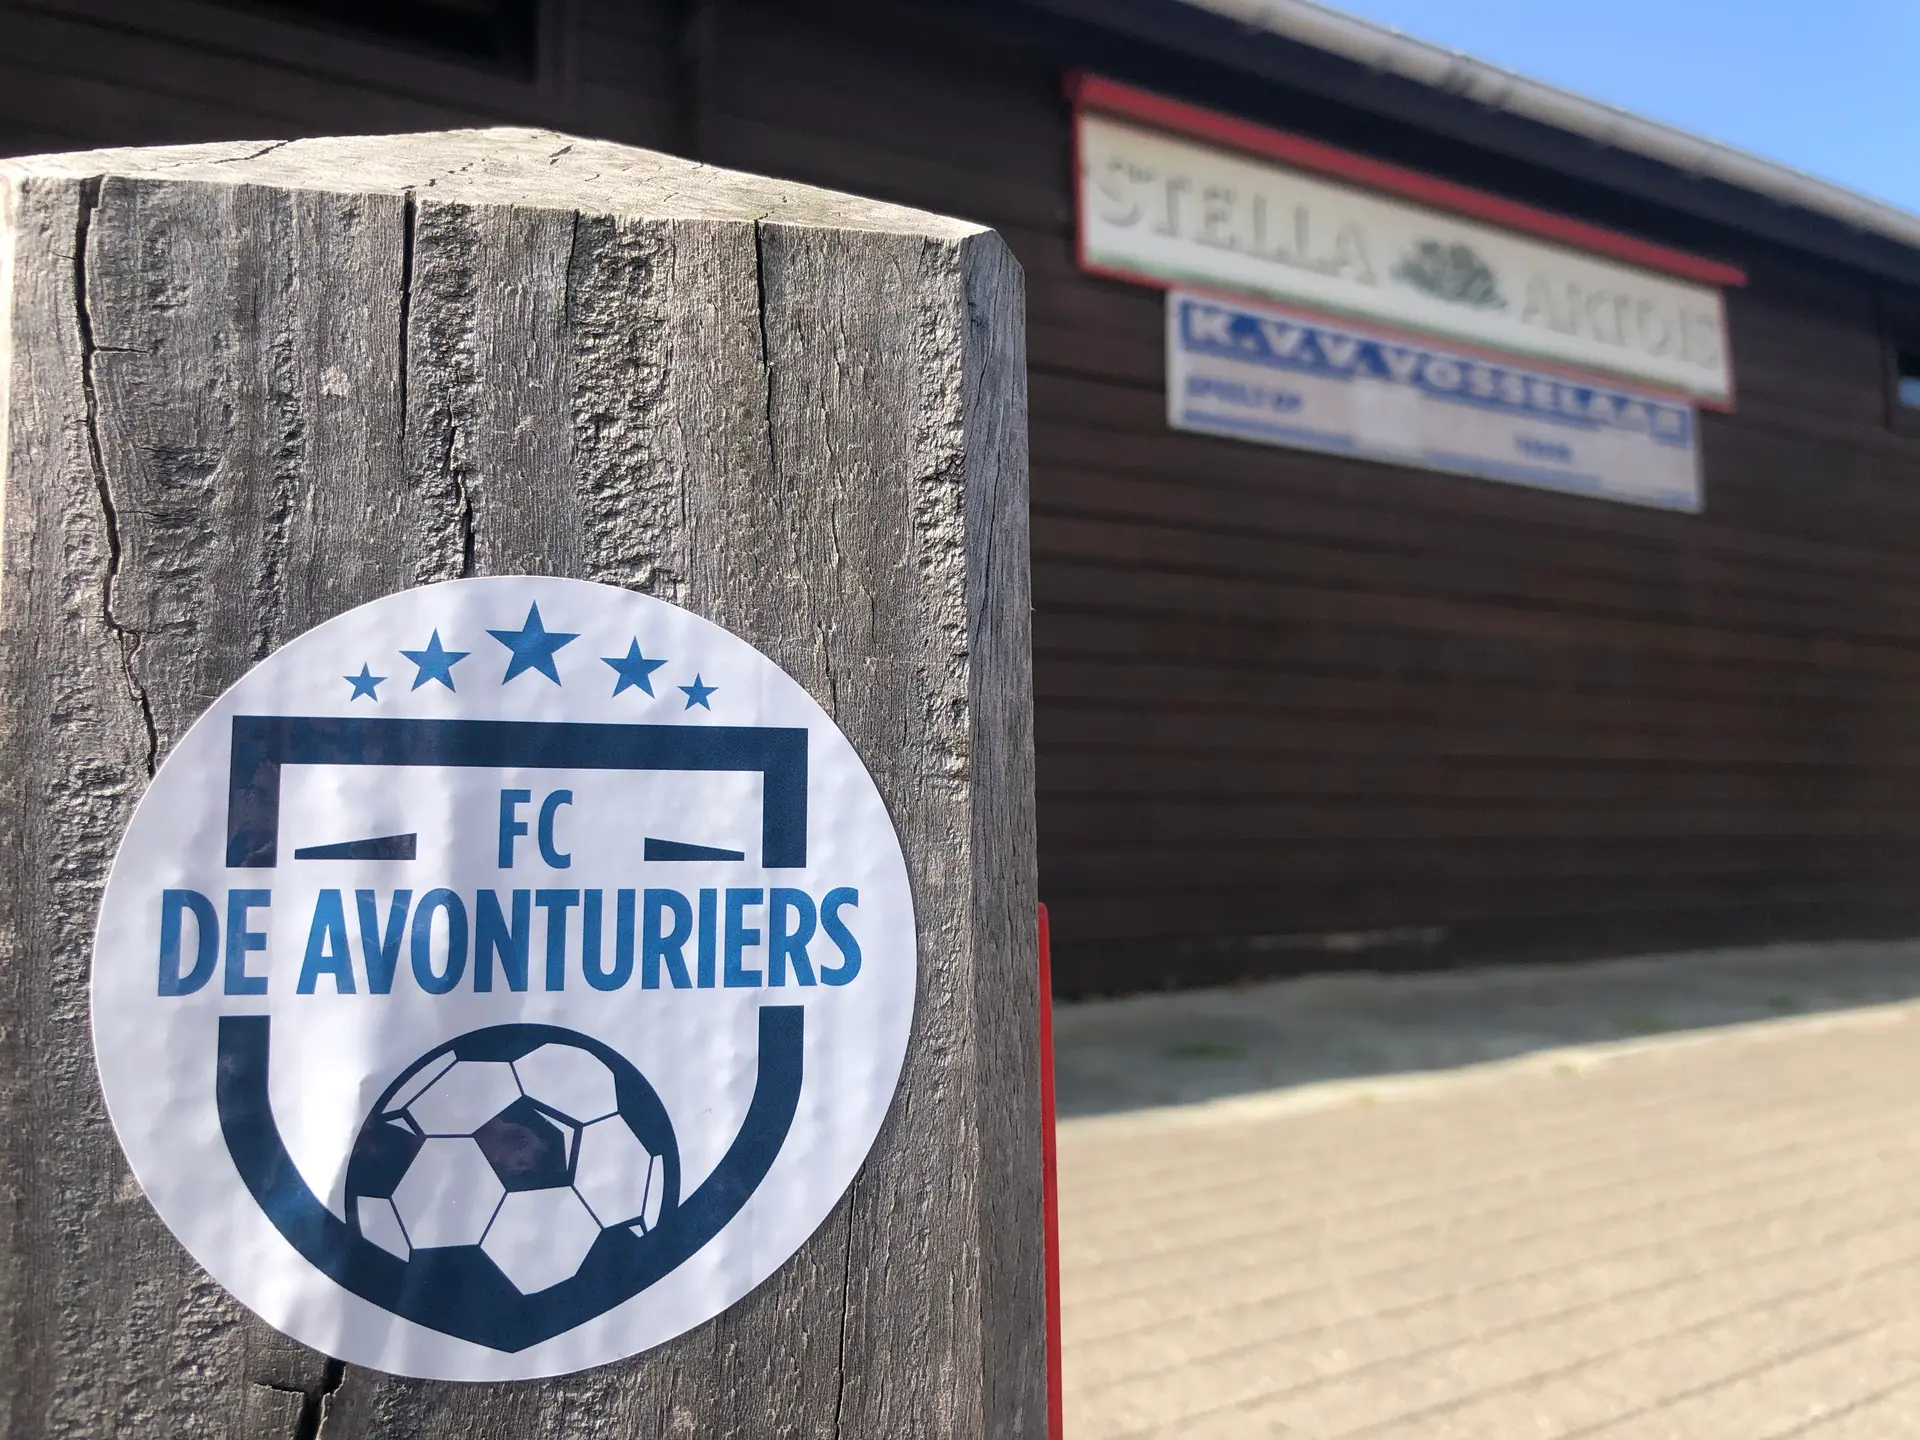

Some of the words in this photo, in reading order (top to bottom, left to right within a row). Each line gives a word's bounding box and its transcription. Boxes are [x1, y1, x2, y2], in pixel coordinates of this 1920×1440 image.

[1086, 153, 1378, 286] STELLA
[498, 788, 573, 869] FC
[158, 888, 272, 996] DE
[296, 886, 862, 995] AVONTURIERS
